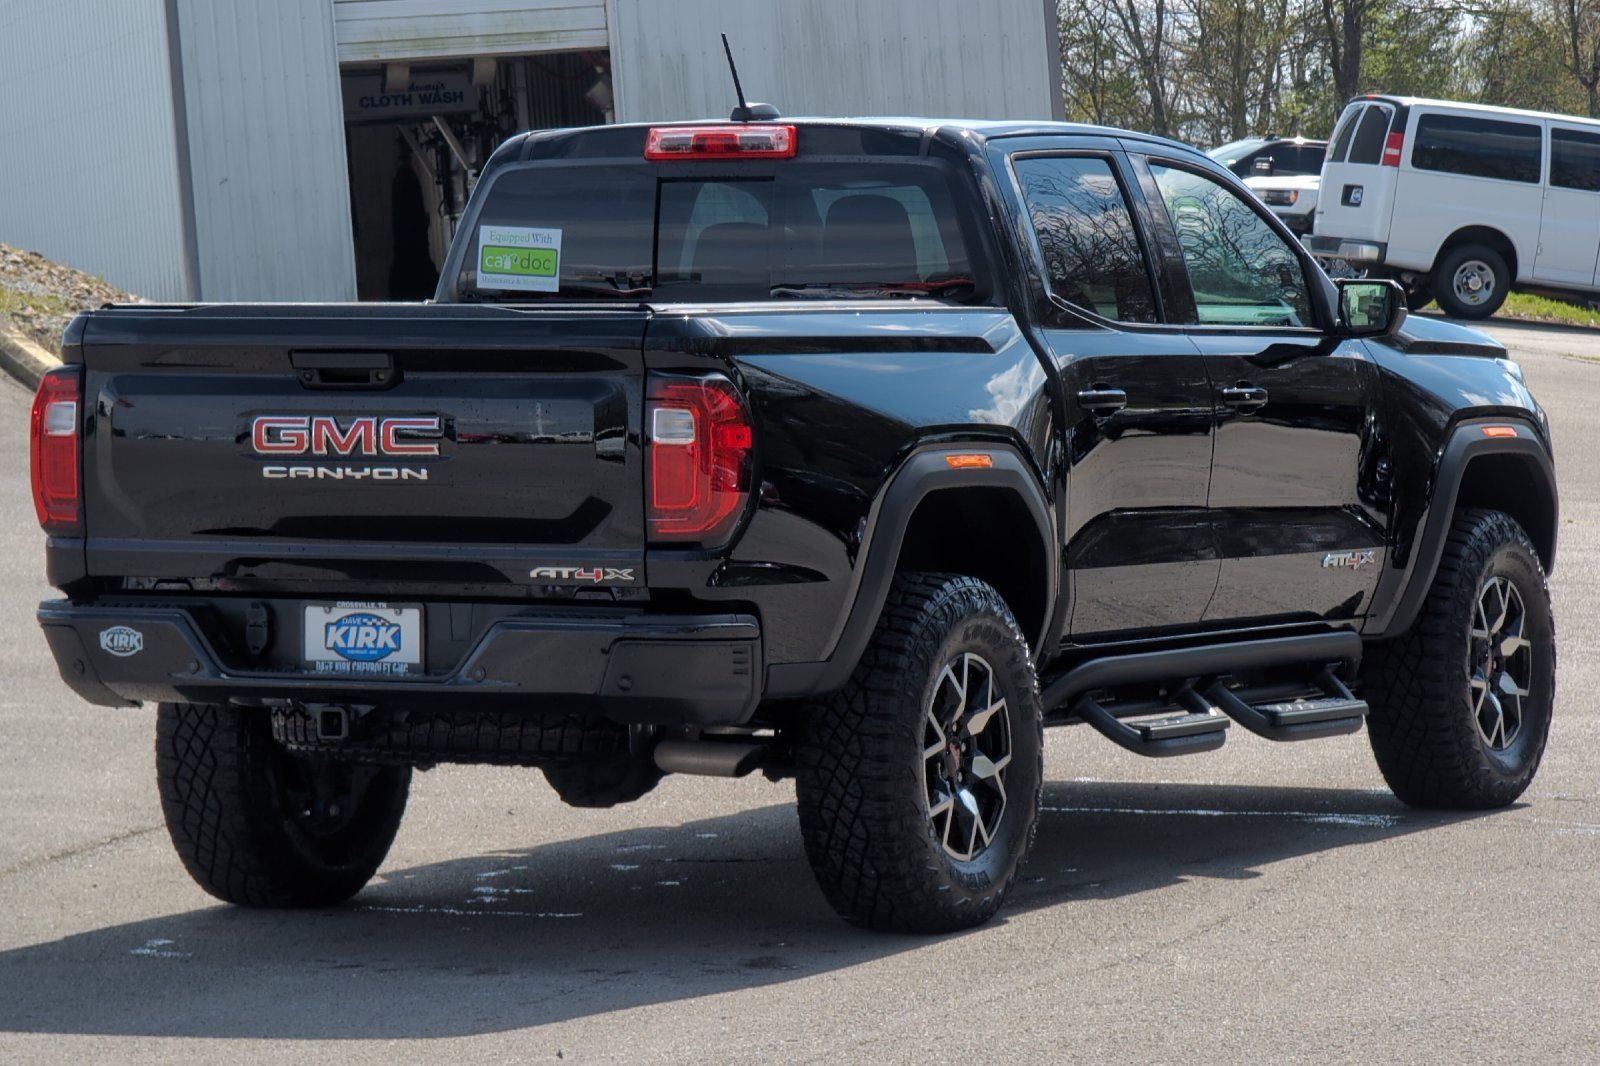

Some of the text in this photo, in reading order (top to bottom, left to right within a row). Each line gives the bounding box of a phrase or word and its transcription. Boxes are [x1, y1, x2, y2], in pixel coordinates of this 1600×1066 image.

[359, 91, 465, 109] CLOTH WASH
[489, 231, 553, 244] Equipped With
[252, 416, 440, 455] GMC
[262, 466, 428, 480] CANYON
[1322, 550, 1375, 570] AT4X
[529, 566, 635, 583] AT4X
[342, 617, 362, 625] DAVE
[101, 633, 141, 648] KIRK
[326, 626, 399, 649] KIRK
[315, 661, 333, 672] DAVE
[335, 661, 351, 673] KIRK
[352, 661, 392, 673] CHEVROLET
